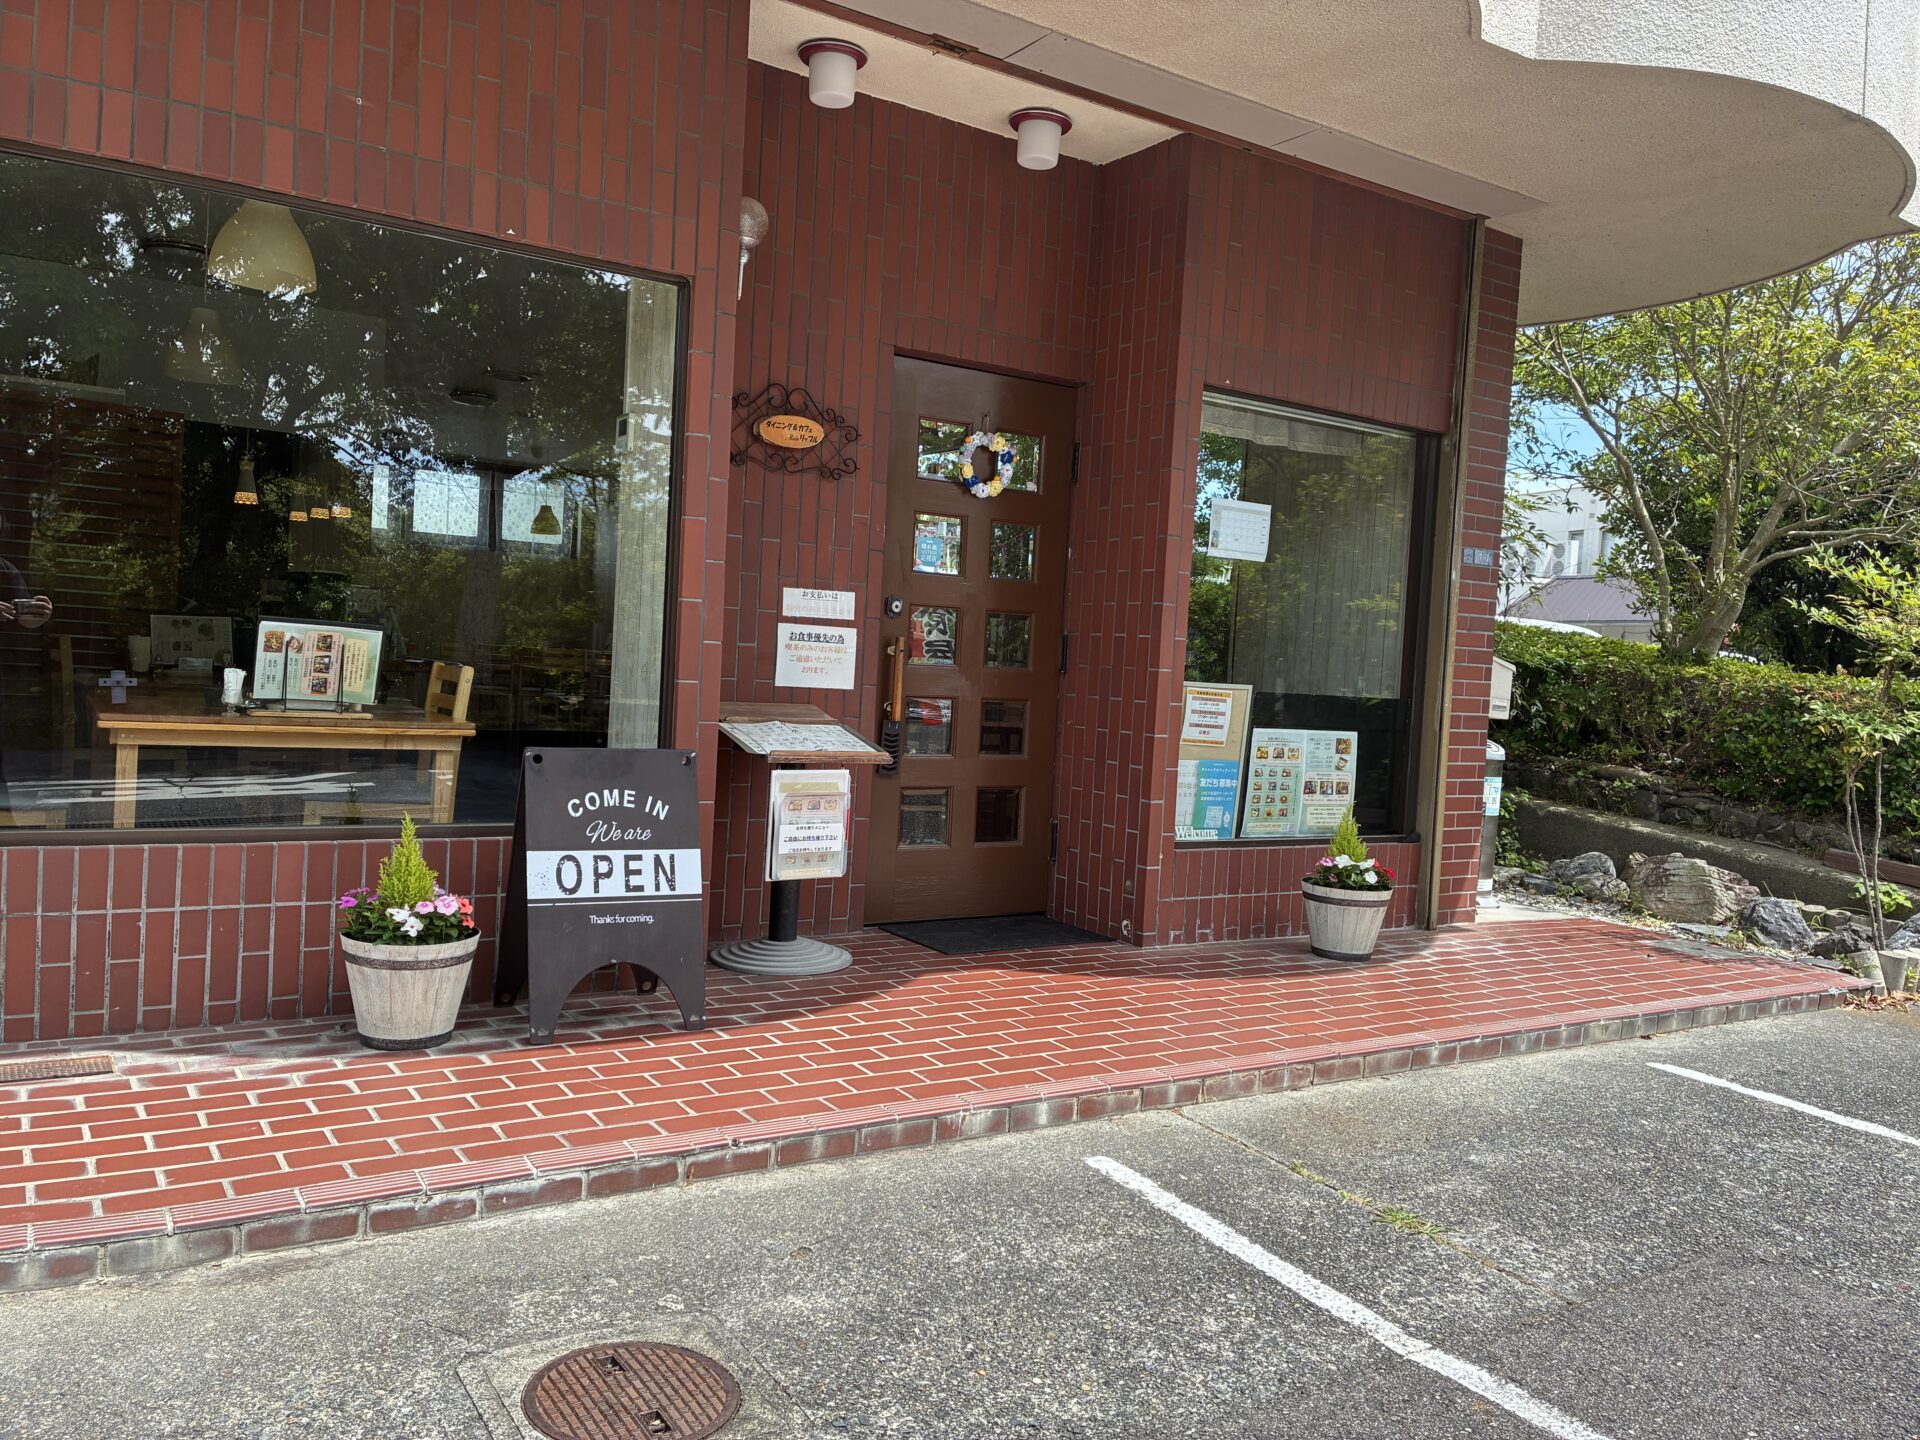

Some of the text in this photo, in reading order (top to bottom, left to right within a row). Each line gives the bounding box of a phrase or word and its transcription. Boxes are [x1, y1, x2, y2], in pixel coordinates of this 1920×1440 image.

[801, 590, 839, 600] お支払いは
[788, 631, 845, 644] お食事優先の為
[784, 643, 848, 655] 喫茶のみのお客様は
[567, 788, 670, 821] COME IN
[585, 819, 652, 844] We are
[1175, 826, 1218, 840] Welcome
[555, 853, 677, 896] OPEN
[589, 914, 655, 925] Thanks for coming.
